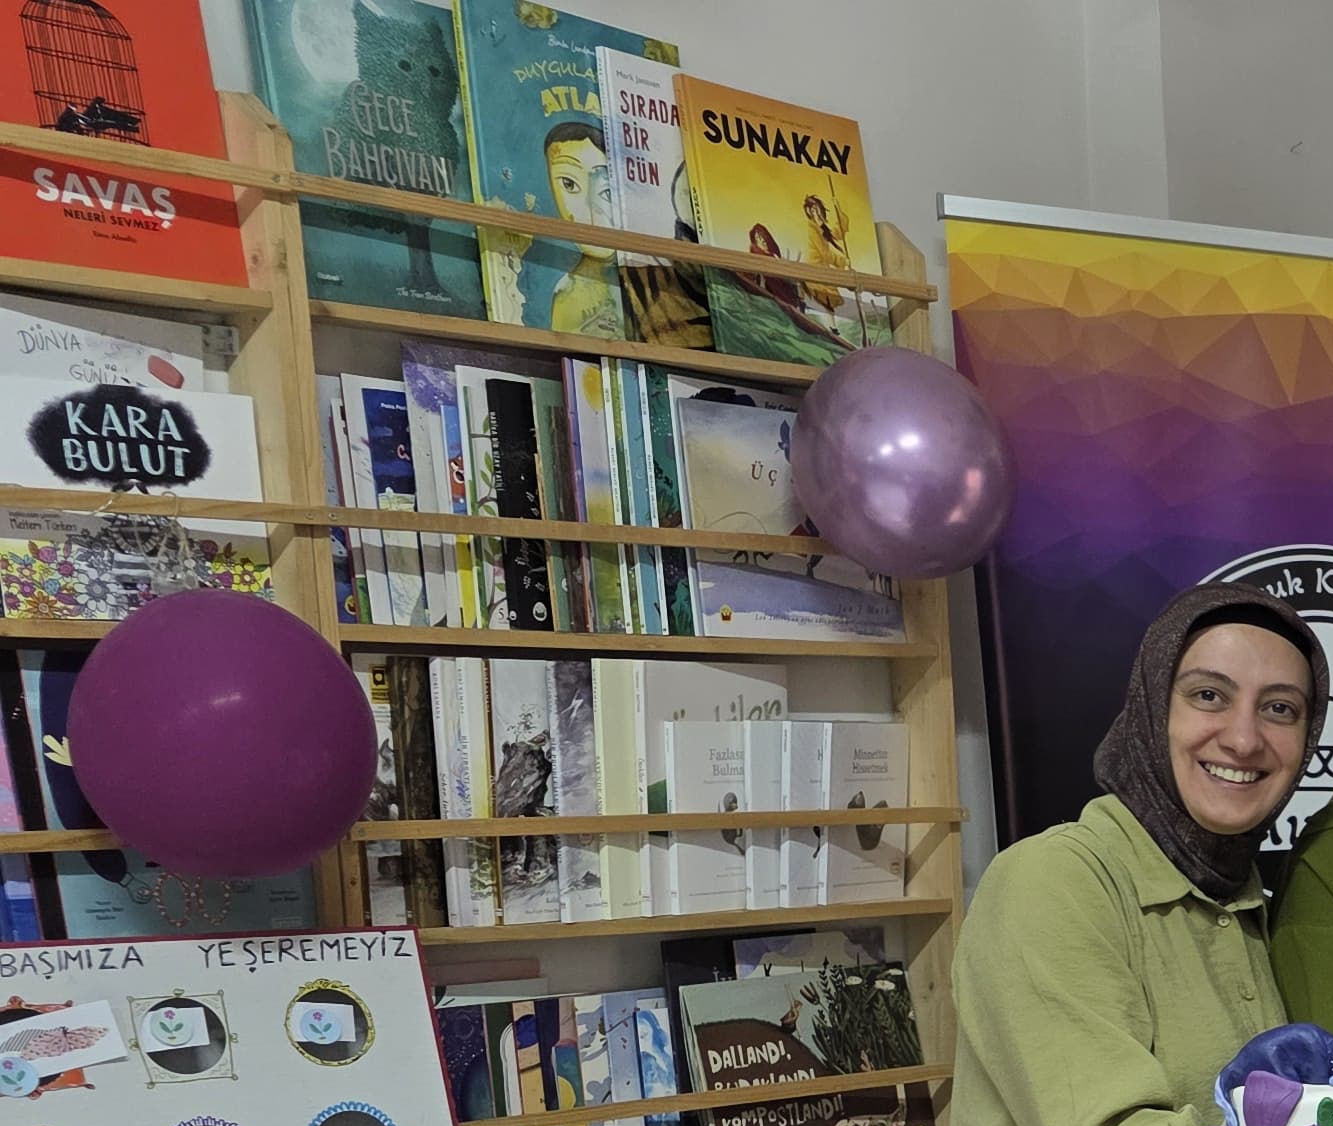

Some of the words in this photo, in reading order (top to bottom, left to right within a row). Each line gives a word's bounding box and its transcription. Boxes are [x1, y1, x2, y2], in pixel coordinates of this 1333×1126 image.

[513, 60, 597, 85] DUYGULA
[351, 79, 418, 138] GECE
[541, 85, 602, 118] ATLA
[619, 89, 681, 128] SIRADA
[622, 121, 650, 151] BİR
[702, 109, 852, 175] SUNAKAY
[322, 127, 457, 198] BAHÇIVANI
[626, 157, 661, 188] GÜN
[33, 166, 176, 230] SAVAŞ
[63, 207, 106, 224] NELERİ
[110, 216, 161, 232] SEVMEZ
[17, 323, 81, 354] DÜNYA
[64, 399, 184, 442] KARA
[62, 437, 193, 478] BULUT
[712, 763, 745, 778] Bulma
[0, 945, 145, 980] BAŞIMIZA
[198, 930, 414, 973] YEŞEREMEYİZ
[707, 1039, 792, 1074] DALLANDI,
